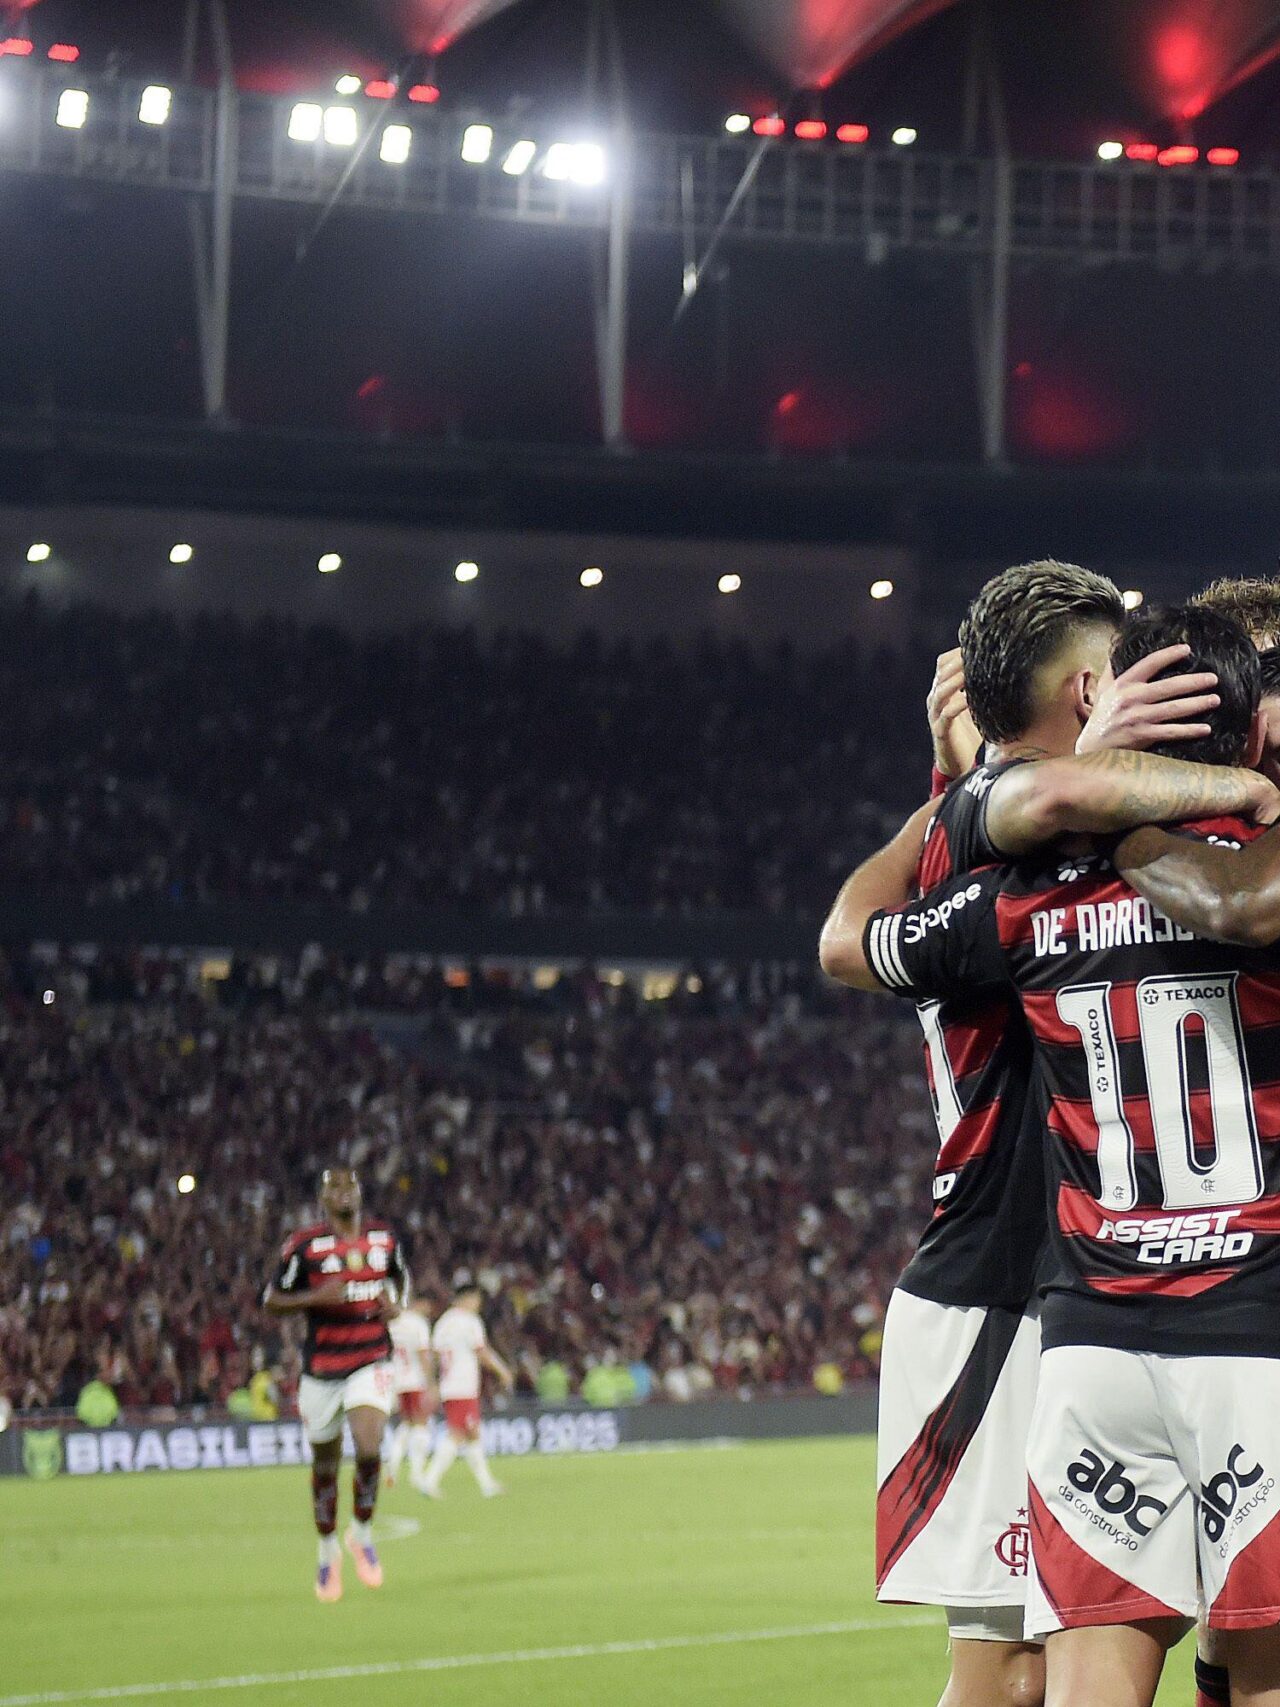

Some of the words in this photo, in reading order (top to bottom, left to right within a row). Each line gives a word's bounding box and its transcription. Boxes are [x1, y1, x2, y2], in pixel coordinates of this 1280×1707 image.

[1030, 908, 1067, 957] DE
[1164, 985, 1226, 1002] TEXACO
[1087, 1008, 1107, 1073] TEXACO
[1056, 970, 1265, 1211] 10
[1096, 1210, 1243, 1243] ASSIST
[1136, 1232, 1254, 1265] CARD
[537, 1410, 620, 1453] 2025
[1058, 1484, 1074, 1503] da
[1073, 1498, 1139, 1552] construção
[1067, 1447, 1169, 1537] abc
[1201, 1443, 1265, 1543] abc
